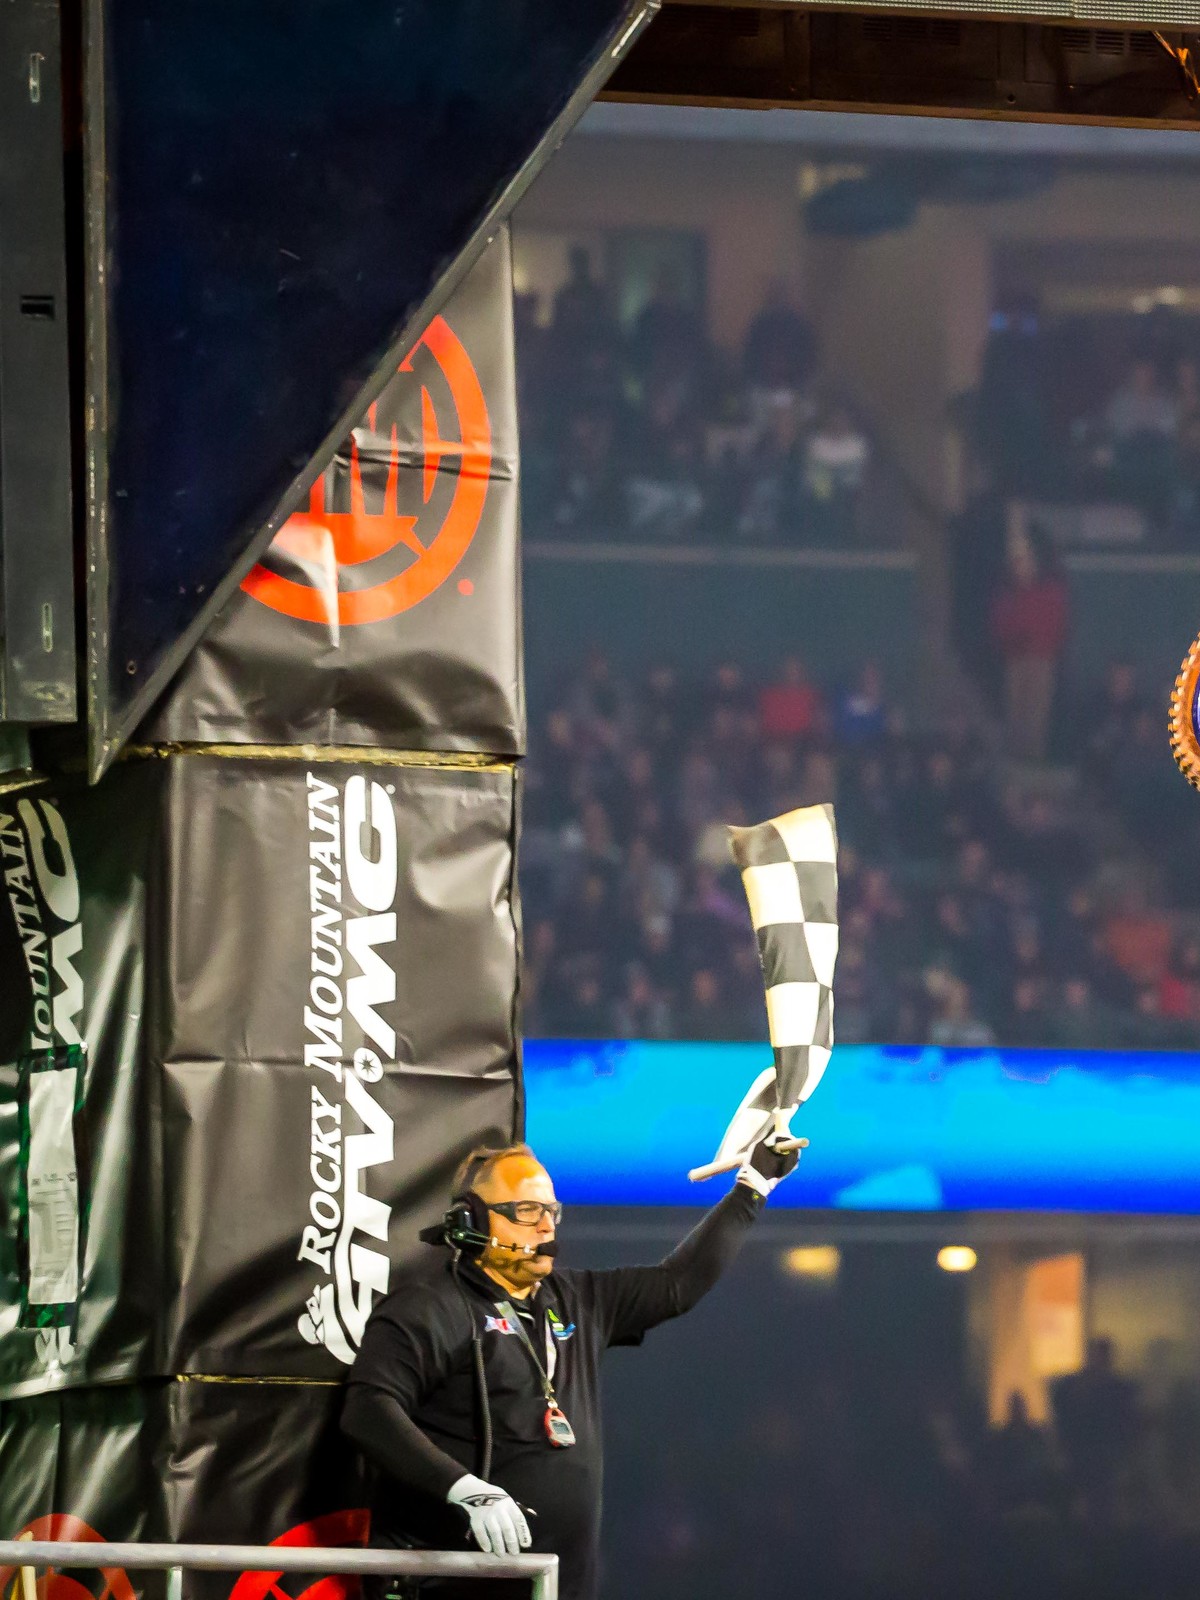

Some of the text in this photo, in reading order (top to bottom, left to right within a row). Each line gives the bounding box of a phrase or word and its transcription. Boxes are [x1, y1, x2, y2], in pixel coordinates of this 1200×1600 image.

[0, 812, 54, 1049] OUNTAIN
[297, 771, 346, 1277] ROCKY MOUNTAIN
